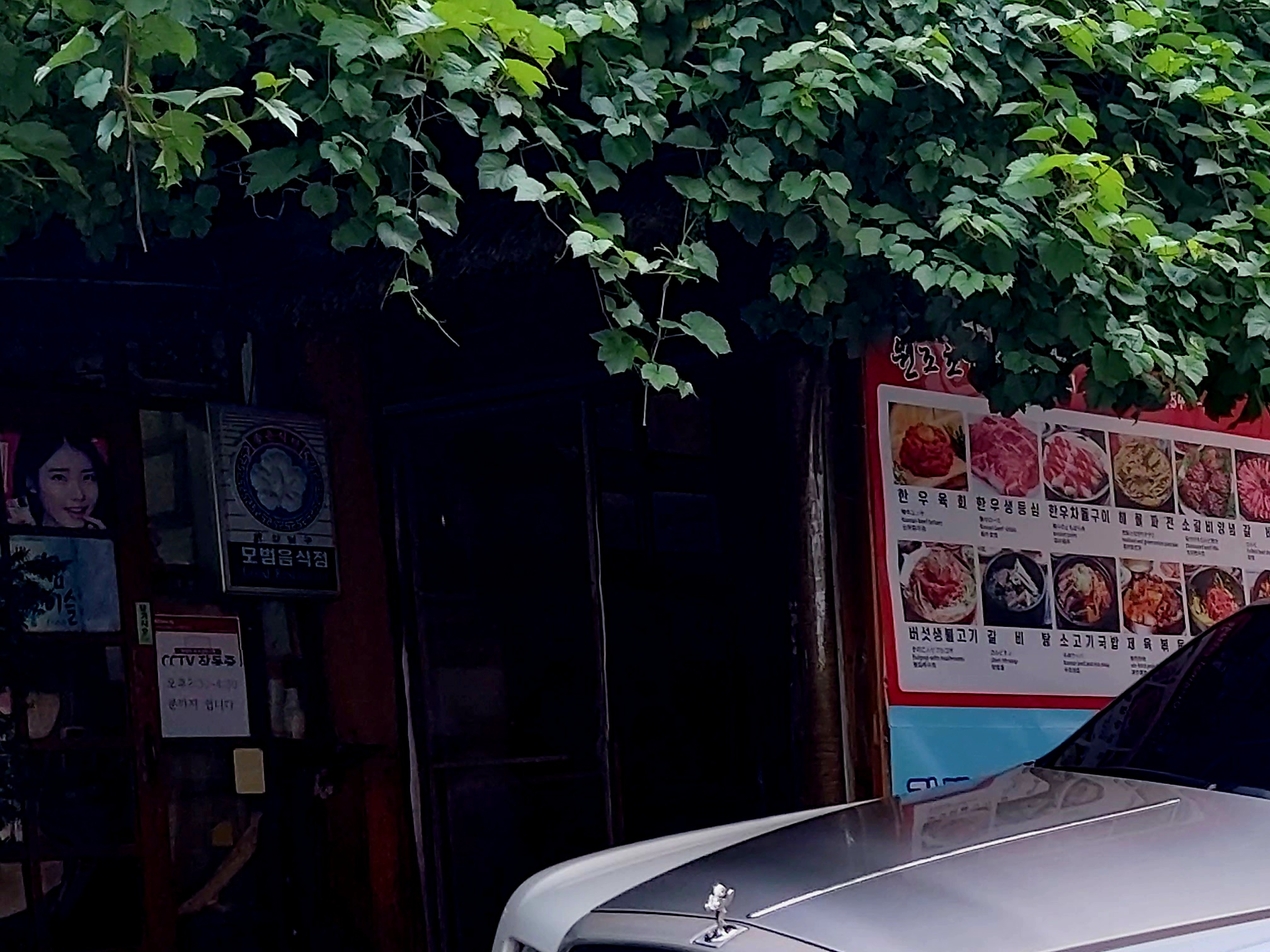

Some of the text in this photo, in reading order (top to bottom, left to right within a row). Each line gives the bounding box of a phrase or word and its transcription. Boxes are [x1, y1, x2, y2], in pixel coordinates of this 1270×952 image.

[897, 487, 968, 510] 한우육회
[975, 496, 1040, 518] 한우생등심
[1048, 503, 1111, 524] 한우차돌구이
[241, 545, 329, 569] 모범음식점
[909, 626, 979, 645] 버섯생불고기
[987, 629, 1051, 648] 갈비탕
[1060, 633, 1120, 651] 소고기국밥
